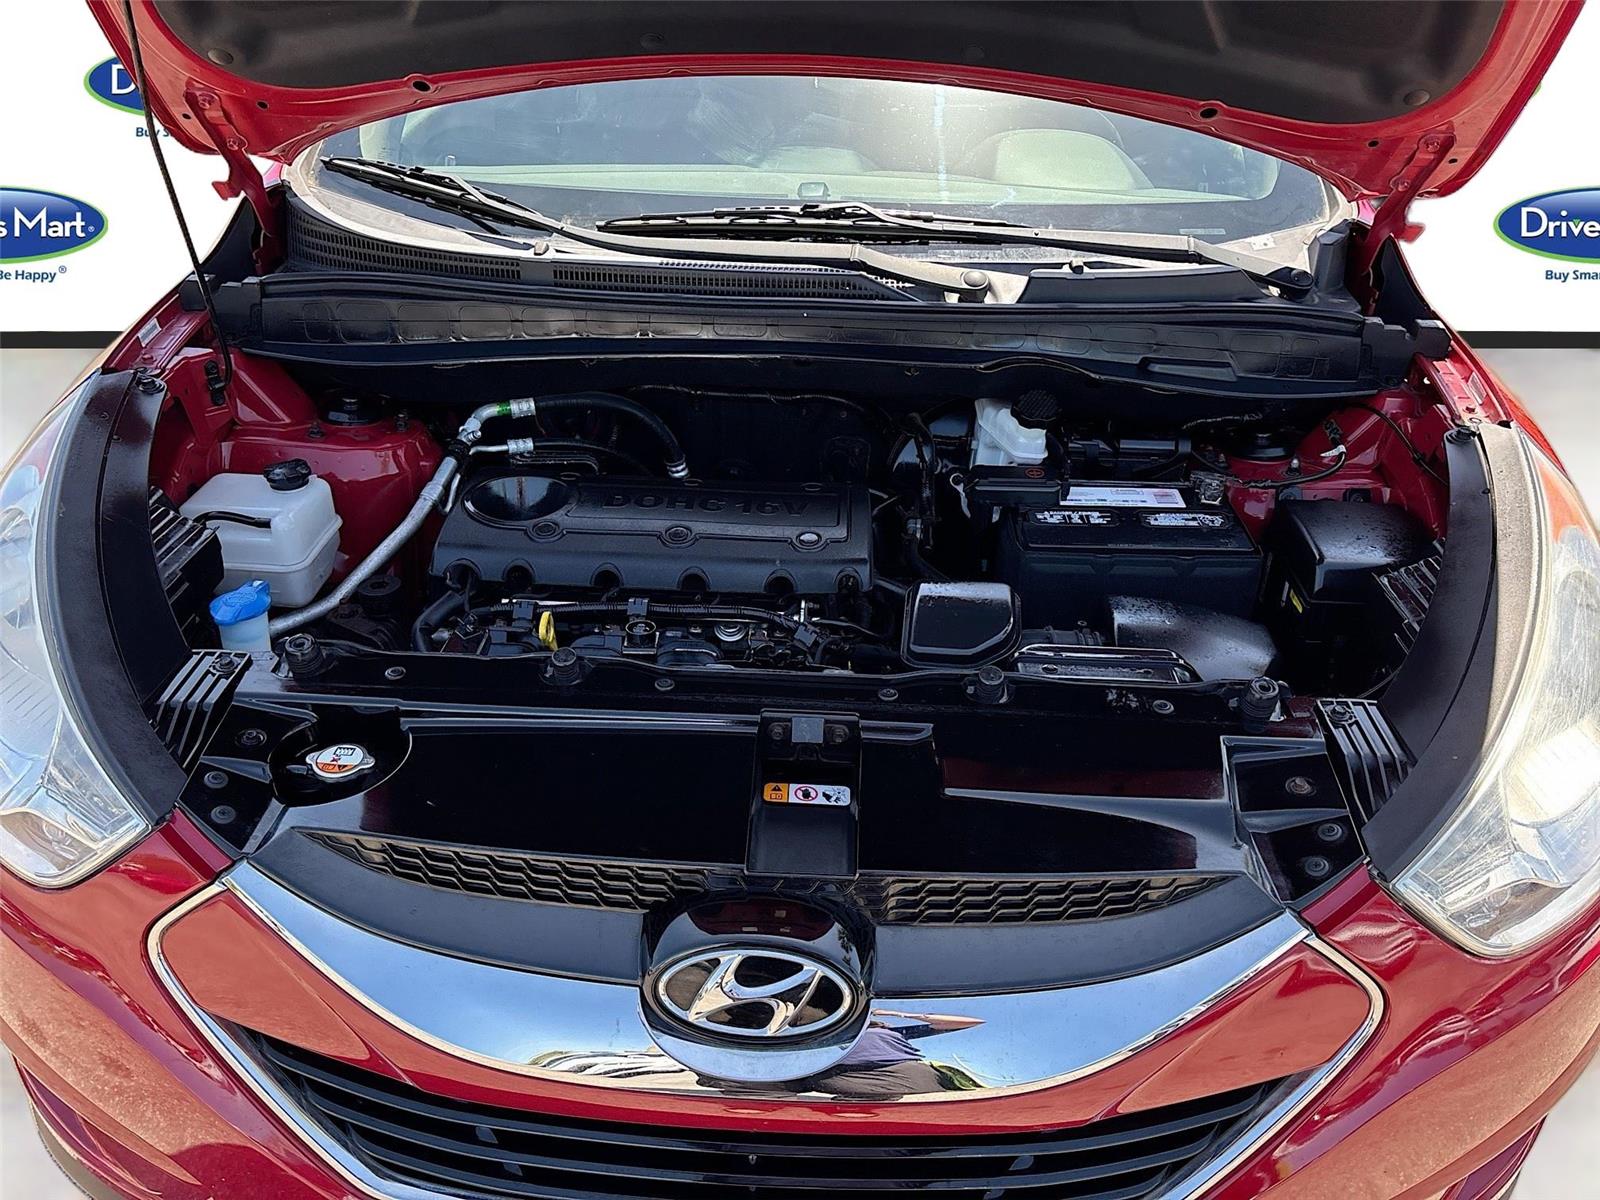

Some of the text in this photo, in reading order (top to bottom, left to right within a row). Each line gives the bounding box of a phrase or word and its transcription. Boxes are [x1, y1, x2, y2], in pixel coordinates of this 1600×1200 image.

[14, 206, 86, 238] Mart
[1521, 206, 1600, 238] Drive
[15, 269, 57, 283] Happy
[1545, 269, 1569, 283] Buy
[602, 495, 809, 516] DOHC 16V
